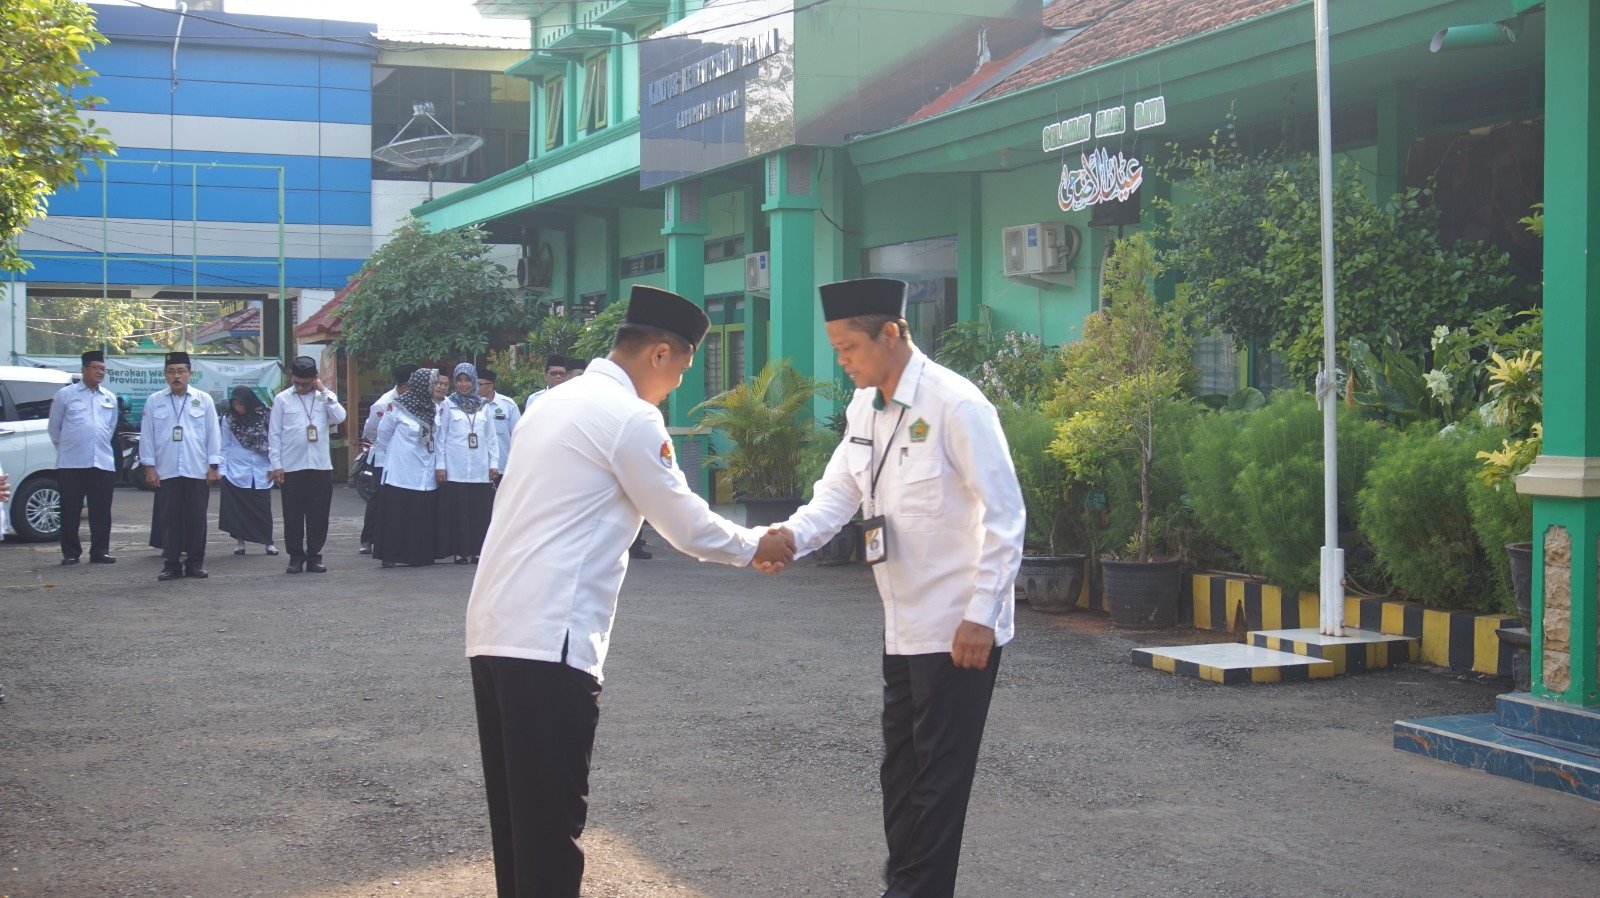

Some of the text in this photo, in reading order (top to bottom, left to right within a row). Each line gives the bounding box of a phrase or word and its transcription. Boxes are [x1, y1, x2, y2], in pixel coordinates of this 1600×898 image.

[649, 71, 681, 107] KANTOR
[676, 100, 716, 129] KABUPATEN
[1043, 96, 1166, 152] SELAMAT HARI RAYA
[108, 369, 147, 377] Gerakan
[110, 376, 147, 384] Provinsi
